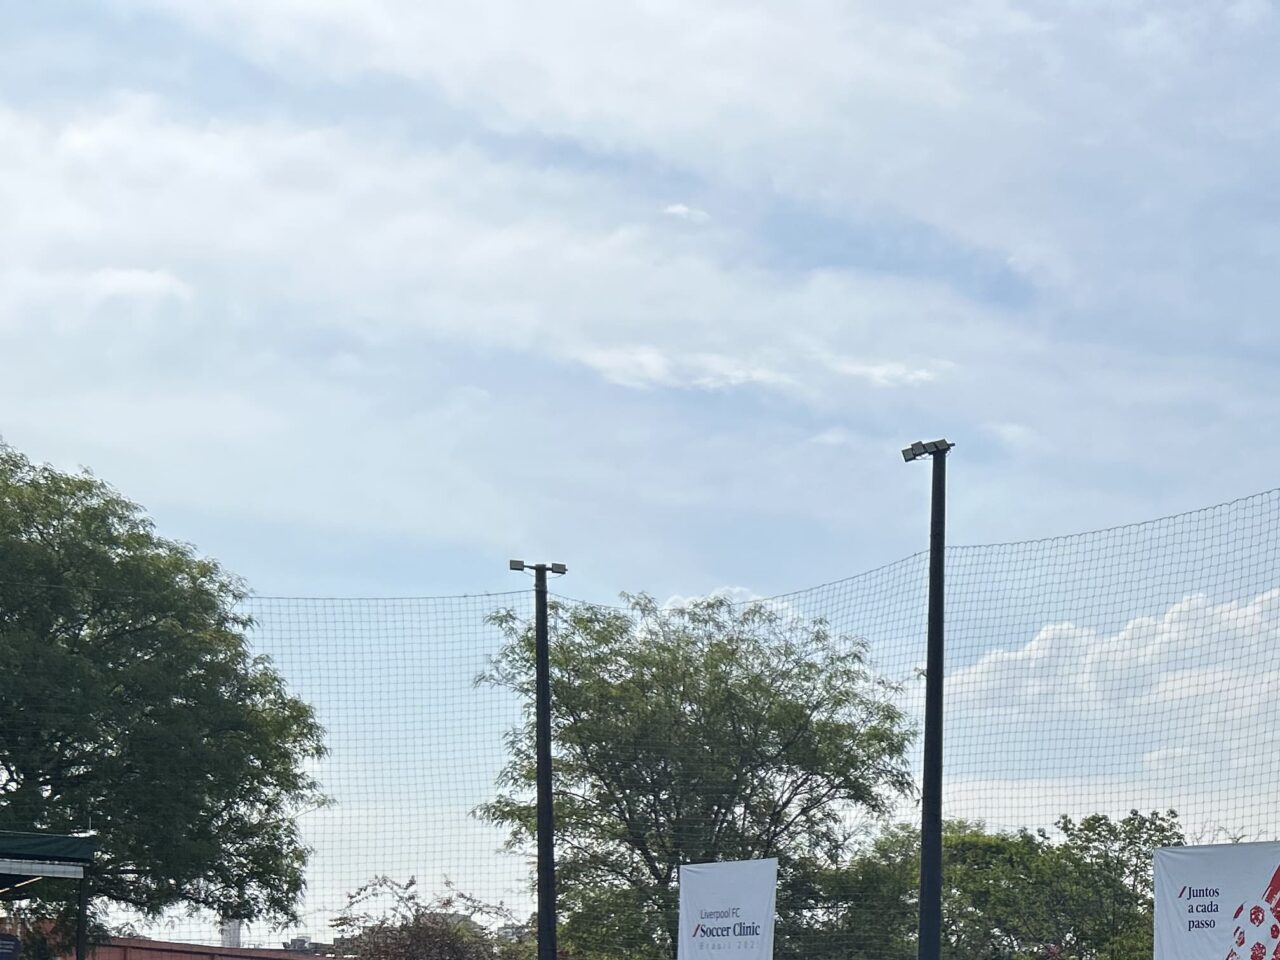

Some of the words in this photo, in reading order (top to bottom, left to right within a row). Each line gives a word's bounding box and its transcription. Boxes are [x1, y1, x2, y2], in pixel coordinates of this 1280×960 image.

[1188, 905, 1194, 913] a
[1196, 901, 1219, 913] cada
[700, 907, 731, 921] Liverpool
[732, 907, 741, 918] FC
[733, 921, 760, 937] Clinic
[1188, 918, 1216, 931] passo
